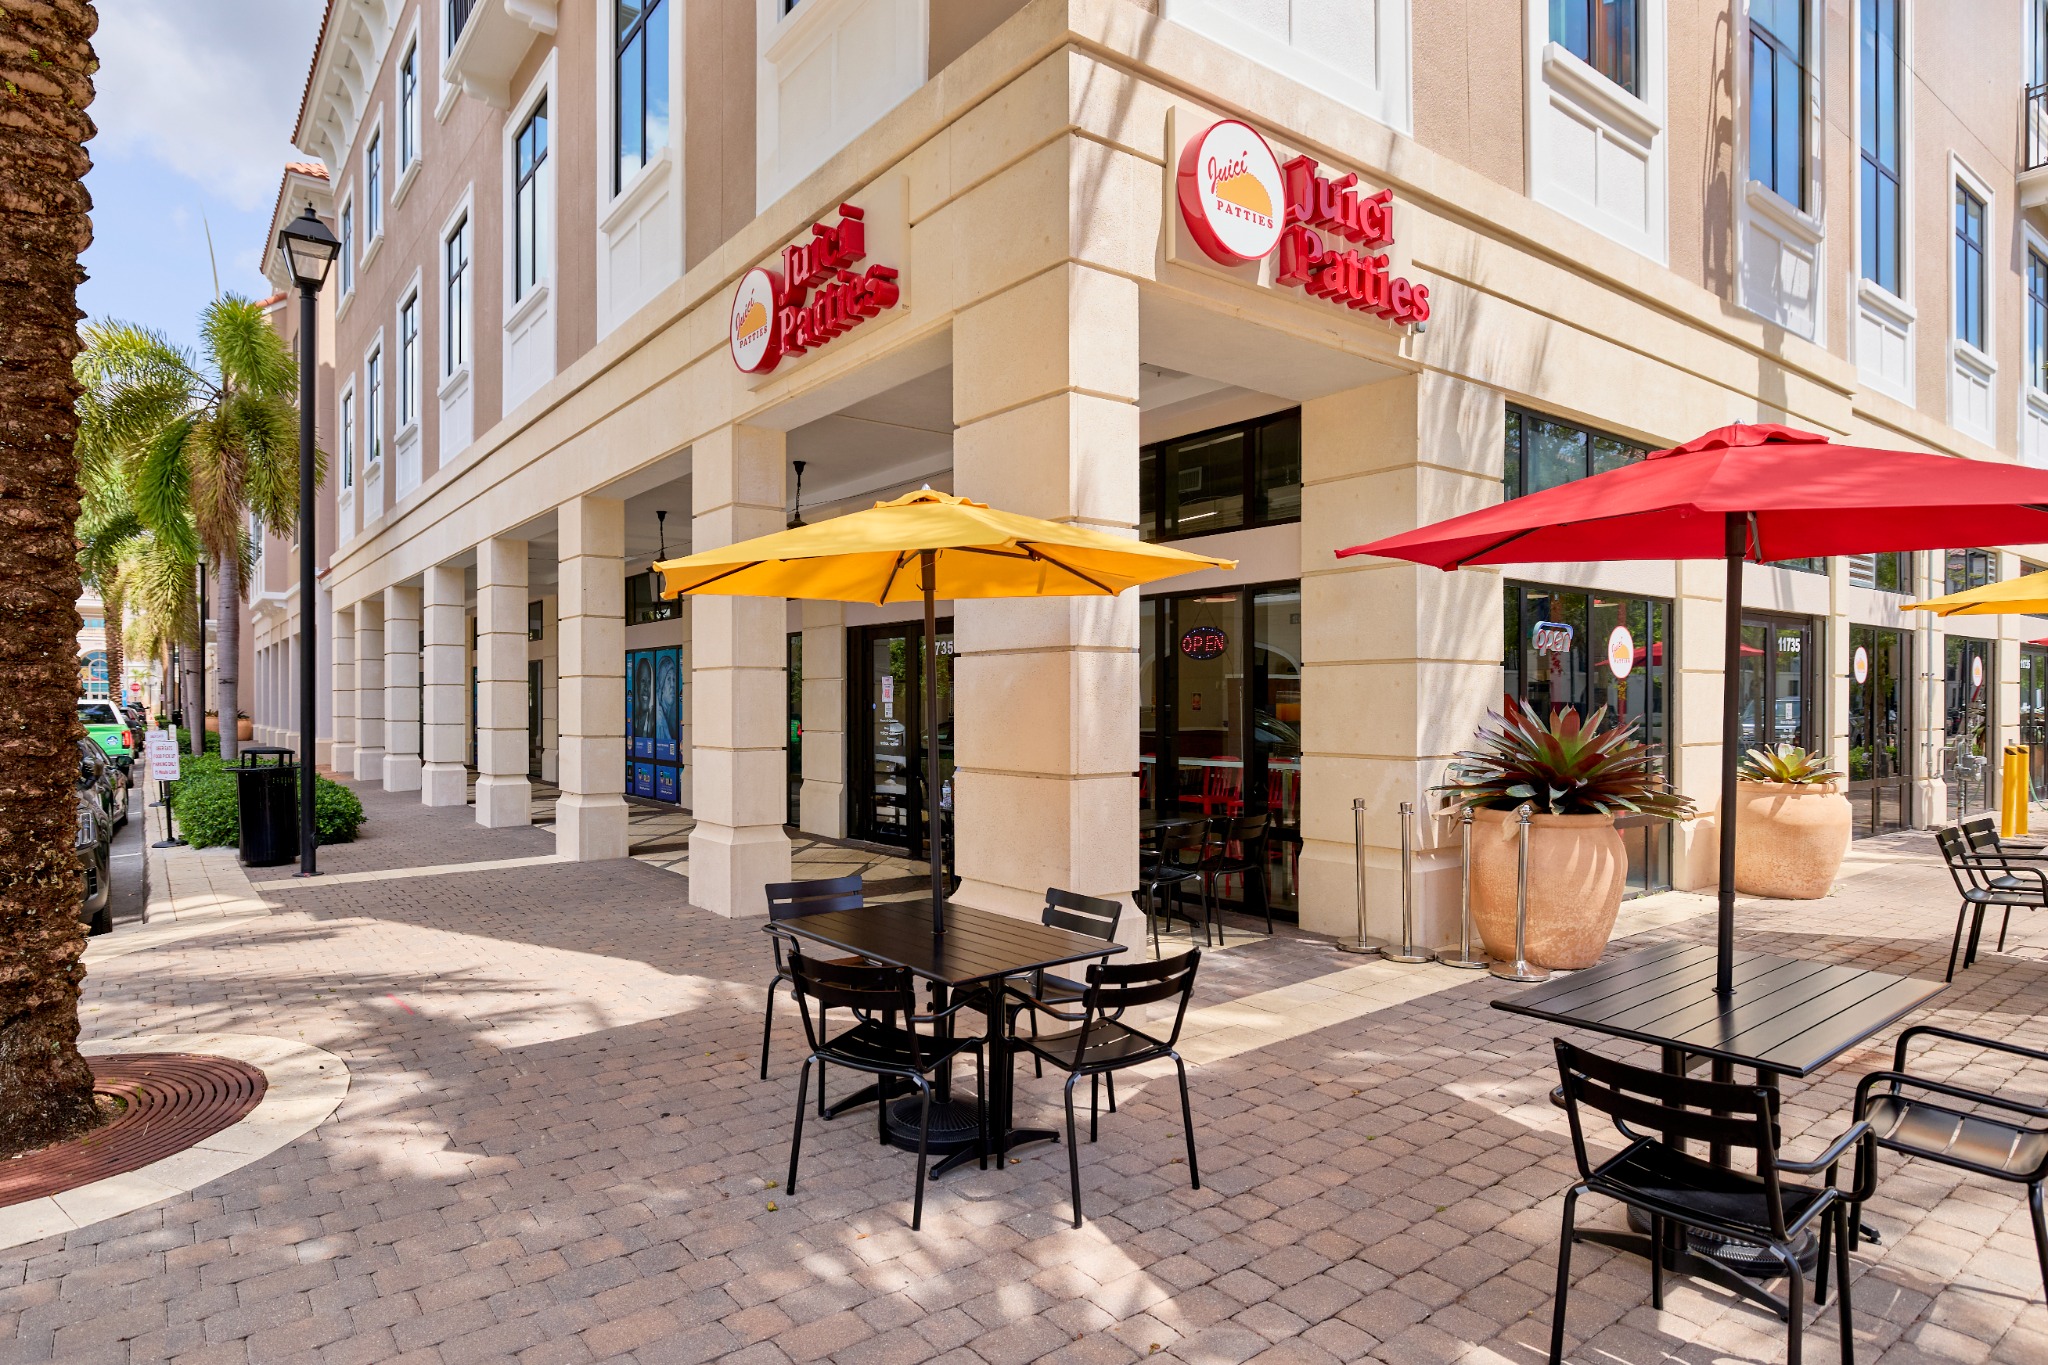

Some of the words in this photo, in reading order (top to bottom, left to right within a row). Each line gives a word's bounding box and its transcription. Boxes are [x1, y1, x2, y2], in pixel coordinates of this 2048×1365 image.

[1207, 150, 1248, 194] Juici
[1216, 199, 1274, 230] PATTIES
[1282, 154, 1395, 250] Juici
[779, 203, 866, 306] Juici
[1276, 224, 1430, 327] Patties
[778, 264, 899, 357] Patties
[739, 325, 768, 349] PATTIES
[1182, 635, 1224, 652] OPEN
[1536, 628, 1572, 656] open
[1778, 637, 1800, 653] 11735
